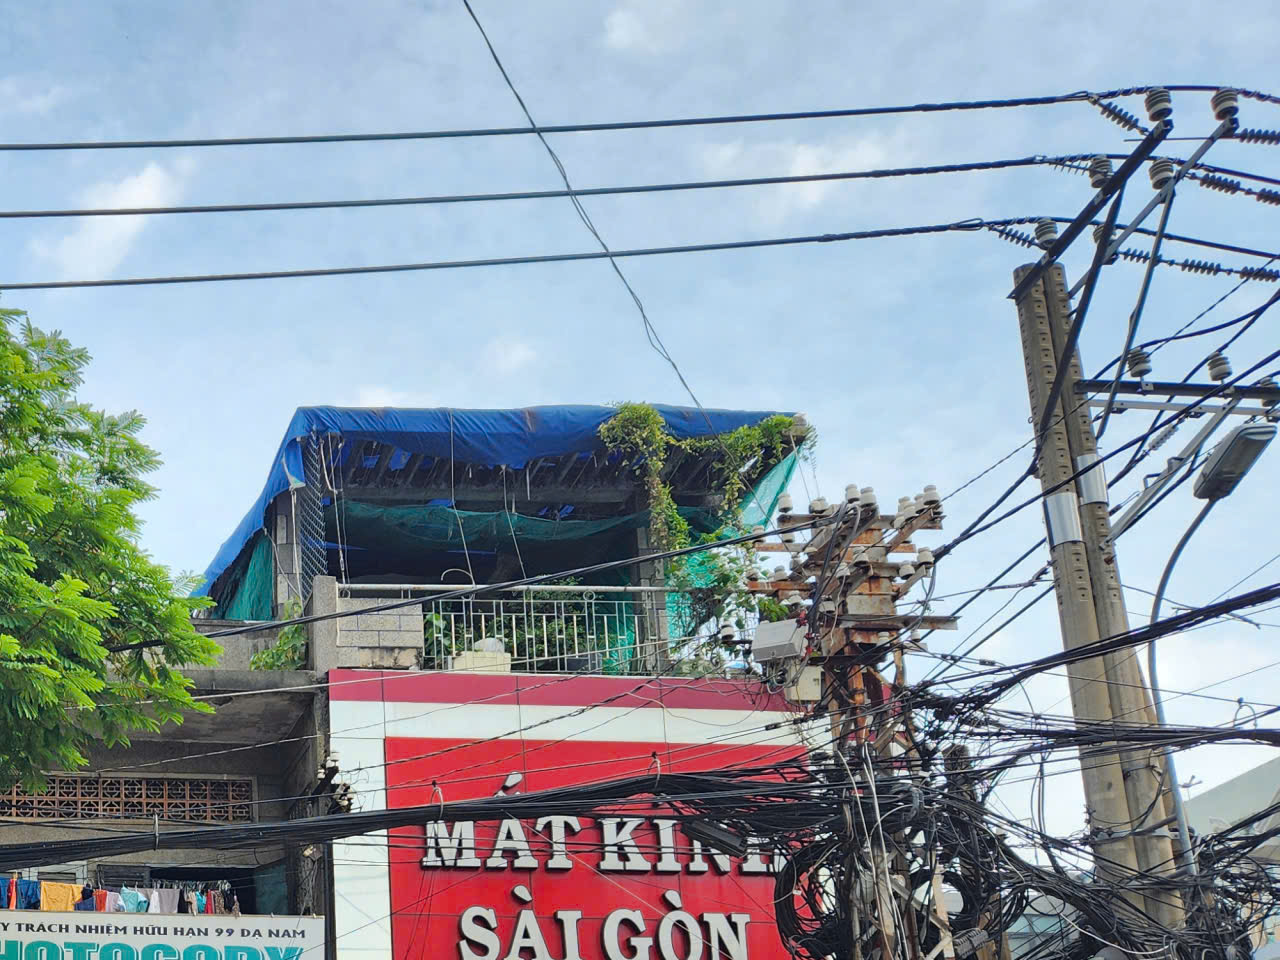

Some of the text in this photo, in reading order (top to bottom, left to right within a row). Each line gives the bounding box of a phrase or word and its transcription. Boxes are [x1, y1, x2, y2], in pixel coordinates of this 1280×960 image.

[15, 921, 69, 933] TRÁCH
[75, 923, 127, 936] NHIỆM
[133, 924, 167, 936] HỮU
[173, 926, 209, 939] HẠN
[215, 927, 234, 937] 99
[268, 928, 305, 939] NAM
